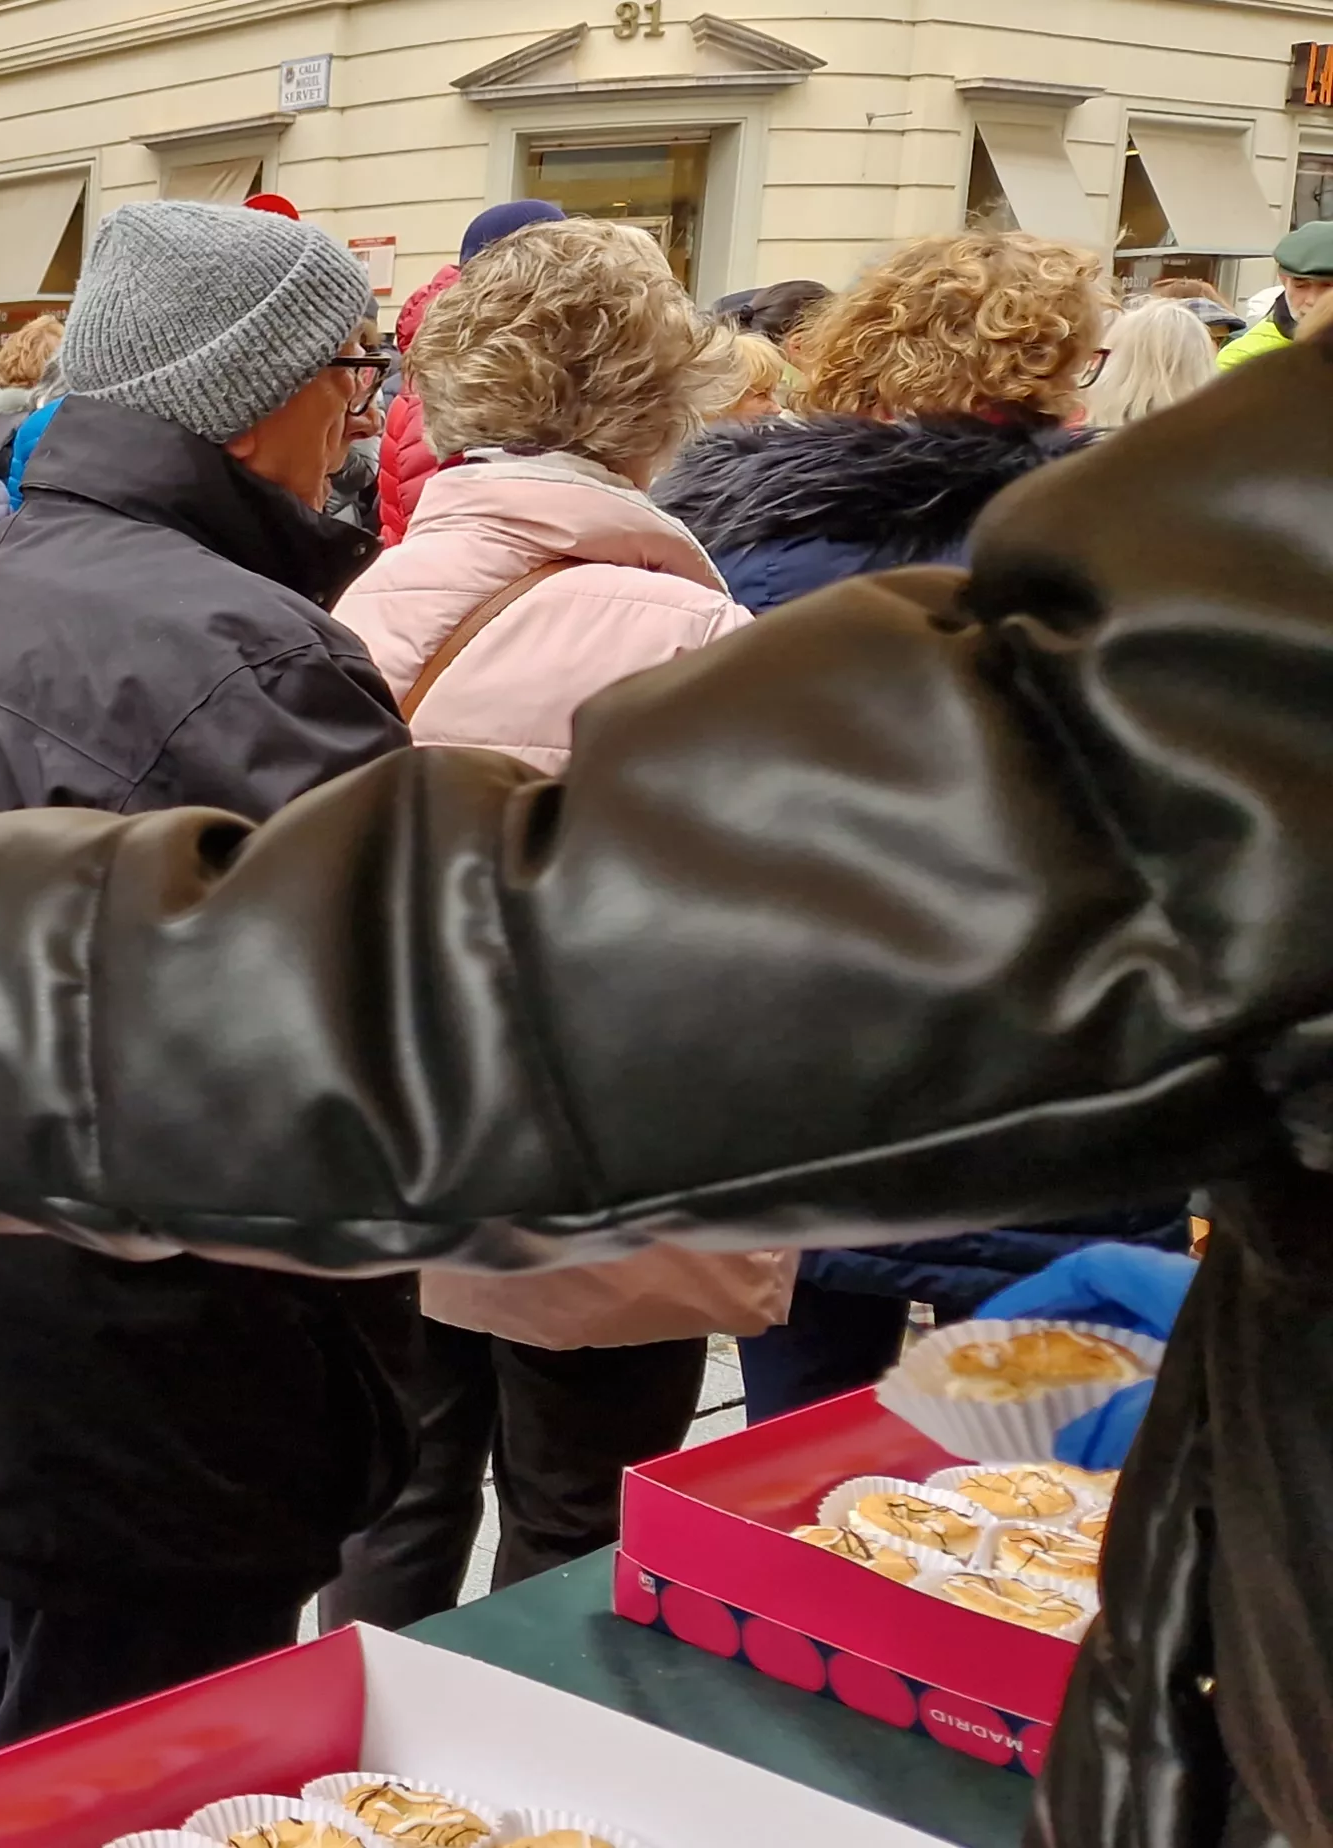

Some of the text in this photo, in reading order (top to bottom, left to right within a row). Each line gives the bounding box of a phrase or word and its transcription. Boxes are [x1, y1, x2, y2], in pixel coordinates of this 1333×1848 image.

[614, 0, 665, 40] 31
[298, 62, 321, 75] CALLE
[284, 87, 322, 102] SERVET
[929, 1708, 1024, 1753] MADRID
